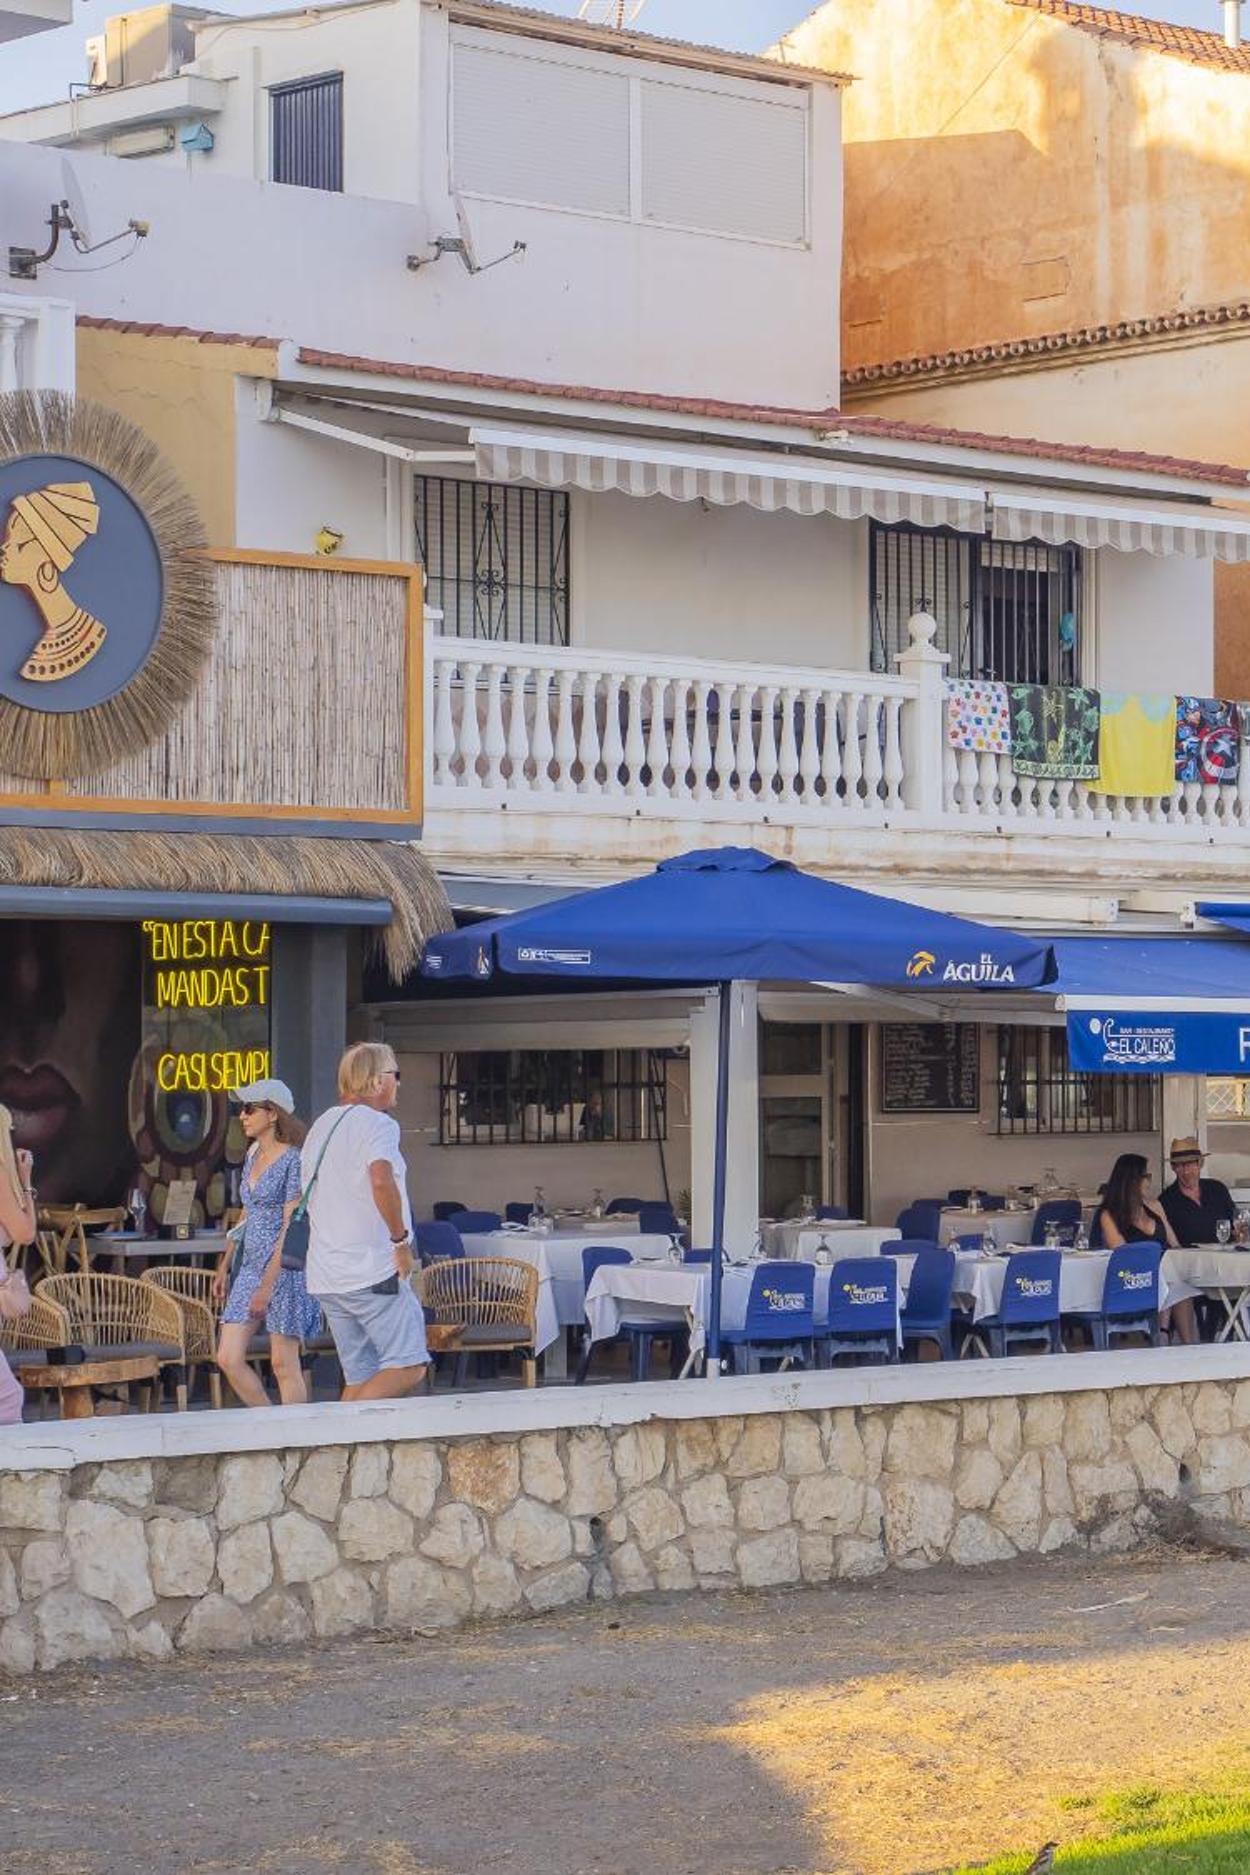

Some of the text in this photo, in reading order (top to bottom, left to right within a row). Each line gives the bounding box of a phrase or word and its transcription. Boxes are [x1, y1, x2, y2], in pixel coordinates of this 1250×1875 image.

[182, 920, 239, 960] ESTA
[980, 953, 993, 964] EL
[157, 967, 250, 1007] MANDAS
[1119, 1038, 1132, 1055] EL
[158, 1053, 208, 1092] CASI
